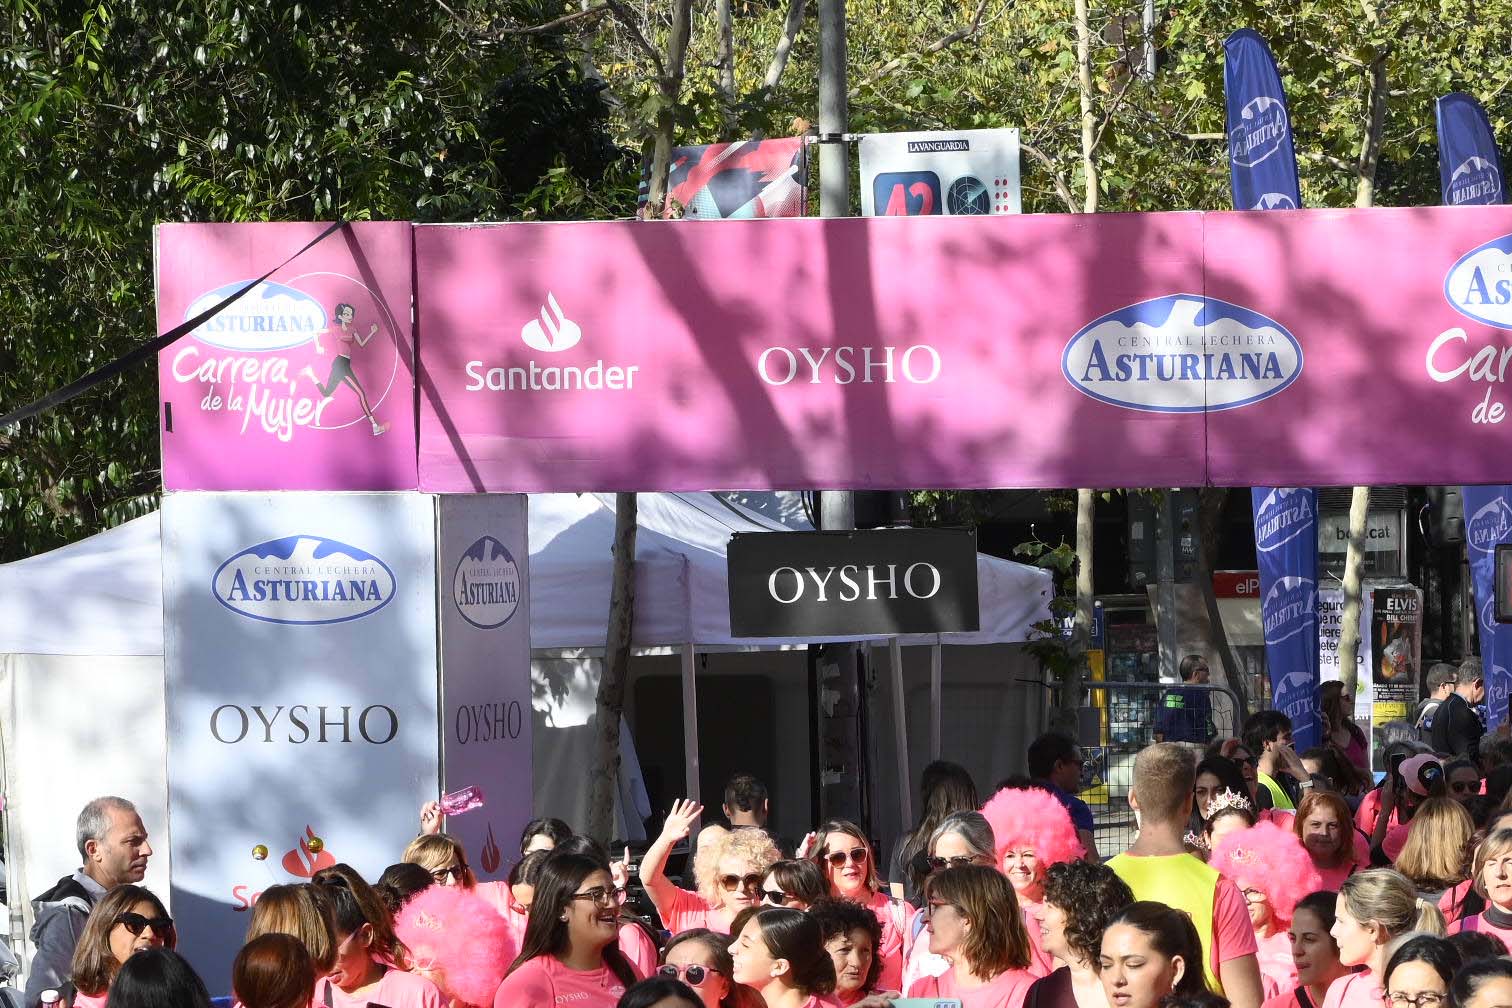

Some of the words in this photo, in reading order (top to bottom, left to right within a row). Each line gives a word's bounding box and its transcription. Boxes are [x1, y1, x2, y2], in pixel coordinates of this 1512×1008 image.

[1118, 336, 1195, 347] CENTRAL
[1201, 334, 1276, 346] LECHERA
[171, 345, 289, 384] Carrera
[465, 359, 639, 391] Santander
[757, 345, 941, 385] OYSHO
[1080, 340, 1284, 383] ASTURIANA
[200, 385, 222, 411] de
[227, 386, 243, 411] la
[240, 380, 334, 442] Mujer
[1471, 386, 1506, 424] de
[226, 568, 383, 602] ASTURIANA
[254, 566, 313, 575] CENTRAL
[318, 566, 376, 575] LECHERA
[459, 570, 517, 606] ASTURIANA
[768, 562, 941, 604] OYSHO
[1386, 598, 1417, 611] ELVIS
[209, 703, 399, 745] OYSHO
[455, 700, 522, 745] OYSHO
[556, 991, 591, 1004] OYSHO
